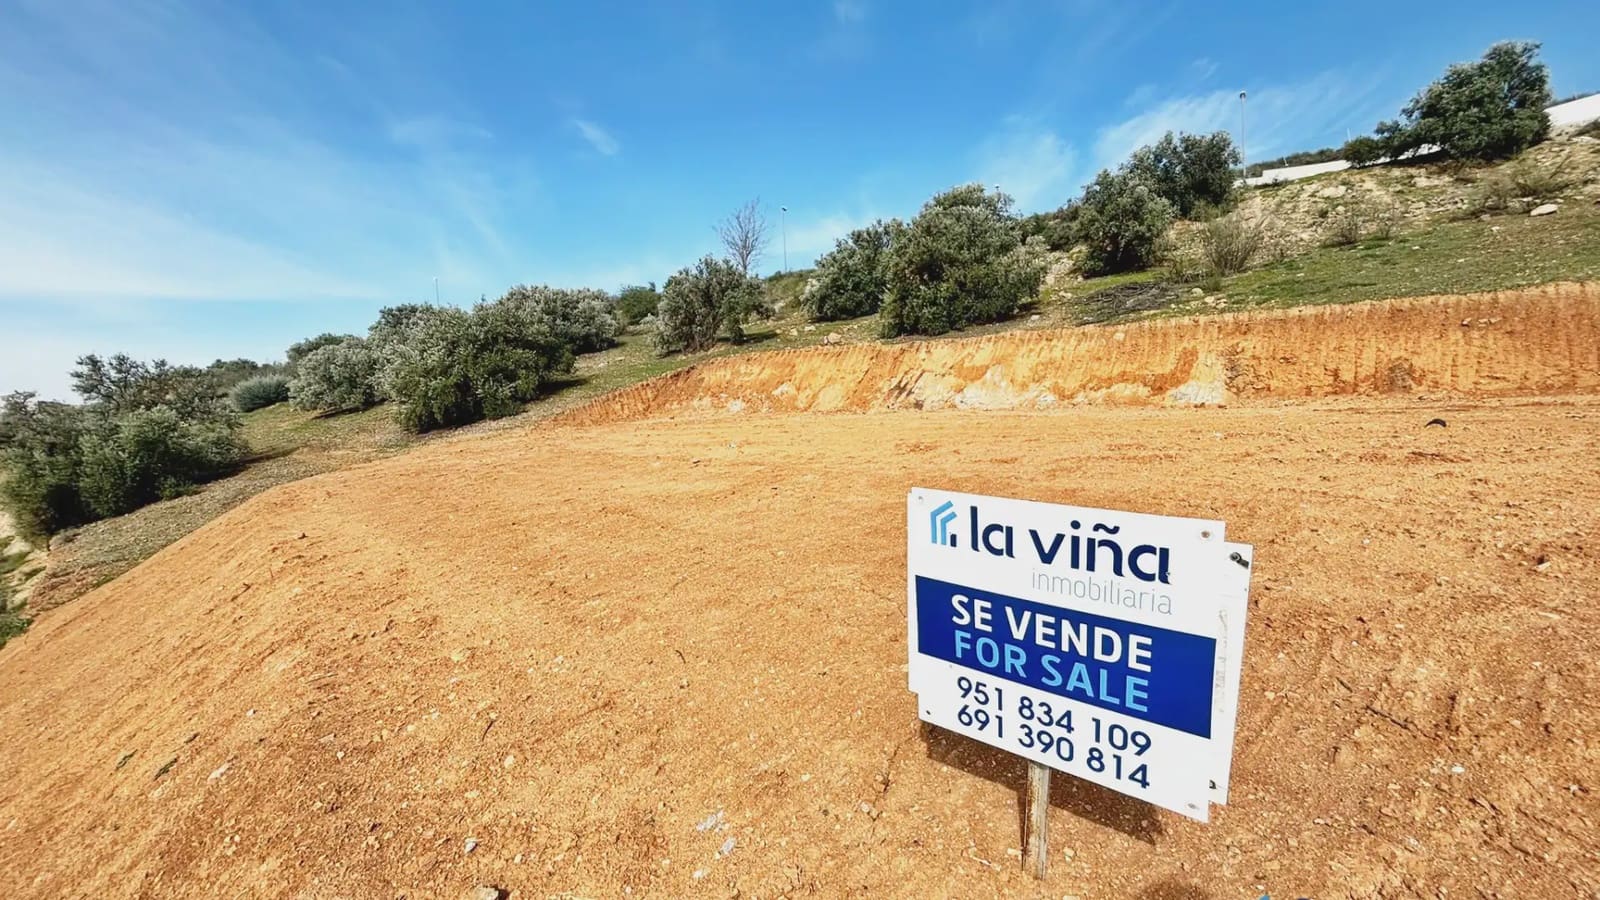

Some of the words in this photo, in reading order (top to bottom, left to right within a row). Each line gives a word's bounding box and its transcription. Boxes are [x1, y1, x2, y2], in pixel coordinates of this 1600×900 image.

[970, 505, 1015, 558] la
[1029, 520, 1171, 585] viña
[1032, 567, 1172, 616] inmobiliaria
[951, 594, 993, 632] SE
[1005, 606, 1153, 673] VENDE
[954, 630, 1028, 678] FOR
[1040, 654, 1149, 713] SALE
[957, 676, 1004, 711] 951
[1018, 695, 1075, 734] 834
[1091, 717, 1152, 756] 109
[957, 704, 1004, 738] 691
[1018, 723, 1074, 762] 390
[1086, 747, 1151, 789] 814
